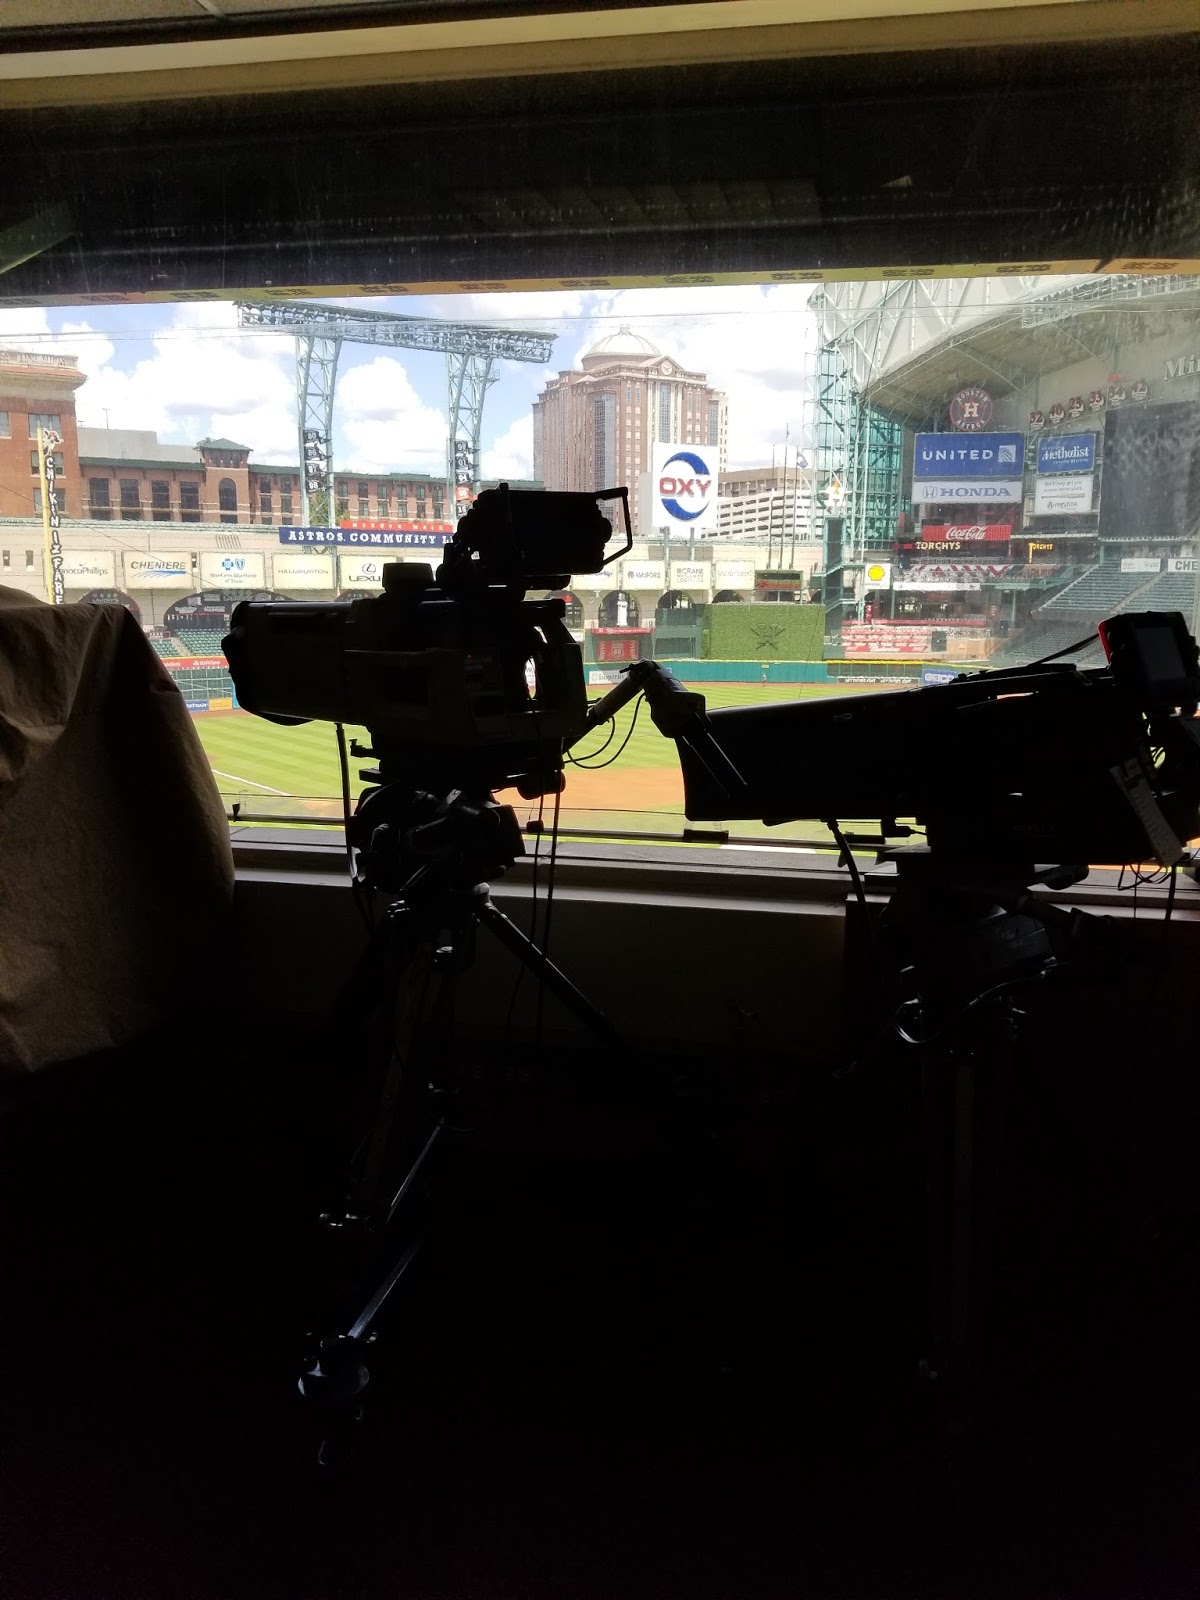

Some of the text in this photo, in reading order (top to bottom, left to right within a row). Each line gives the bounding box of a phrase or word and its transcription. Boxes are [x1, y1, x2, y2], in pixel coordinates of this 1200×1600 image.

[956, 389, 989, 403] HOUSTON
[922, 449, 993, 461] UNITED
[1041, 445, 1089, 461] Methodist
[308, 481, 319, 490] 98
[659, 477, 712, 497] OXY
[939, 487, 1012, 497] HONDA
[288, 530, 343, 542] ASTROS
[349, 532, 437, 545] COMMUNITY
[945, 526, 989, 541] Coca-Cola
[60, 566, 108, 577] nocoPhillips
[130, 561, 187, 570] CHENIERE
